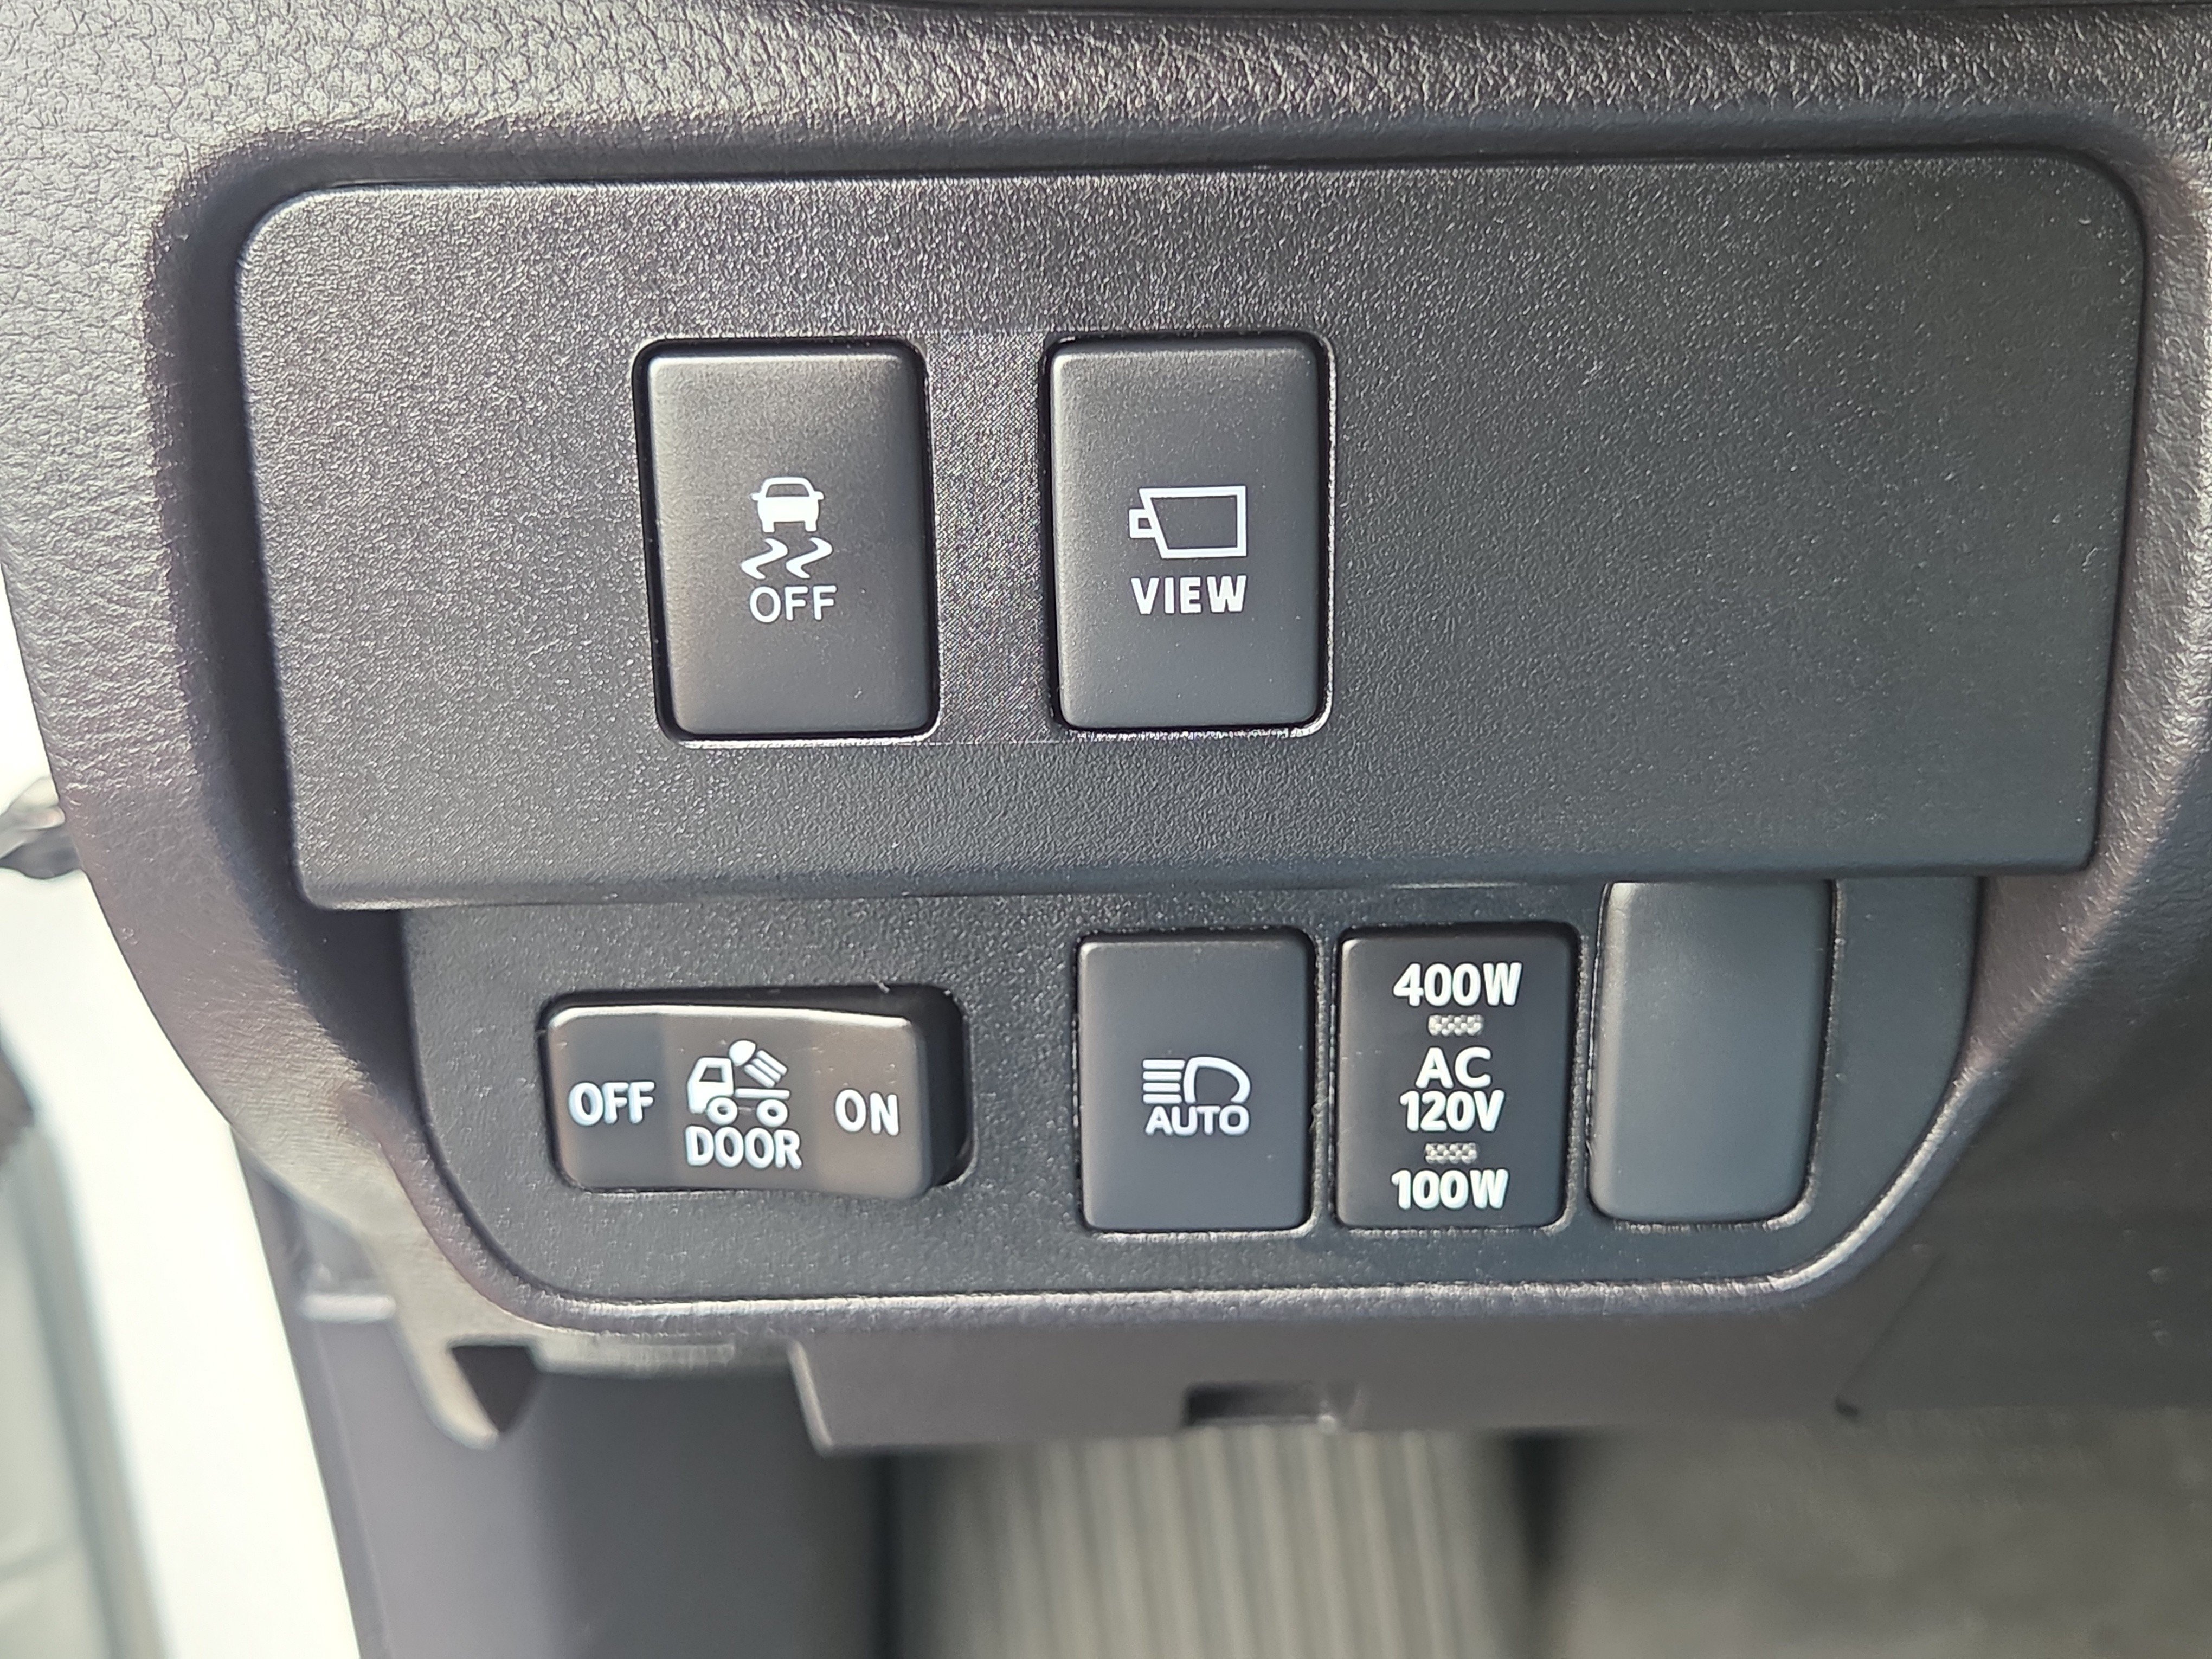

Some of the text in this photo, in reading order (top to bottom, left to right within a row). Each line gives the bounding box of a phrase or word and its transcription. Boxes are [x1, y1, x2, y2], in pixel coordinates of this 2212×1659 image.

[750, 586, 837, 623] OFF
[1131, 575, 1247, 614] VIEW
[1394, 963, 1521, 1006] 400W
[1416, 1047, 1491, 1088] AC
[569, 1082, 654, 1126] OFF
[836, 1088, 899, 1136] ON
[1145, 1105, 1249, 1135] AUTO
[1400, 1089, 1504, 1131] 120V
[686, 1126, 802, 1169] DOOR
[1392, 1169, 1508, 1210] 100W
